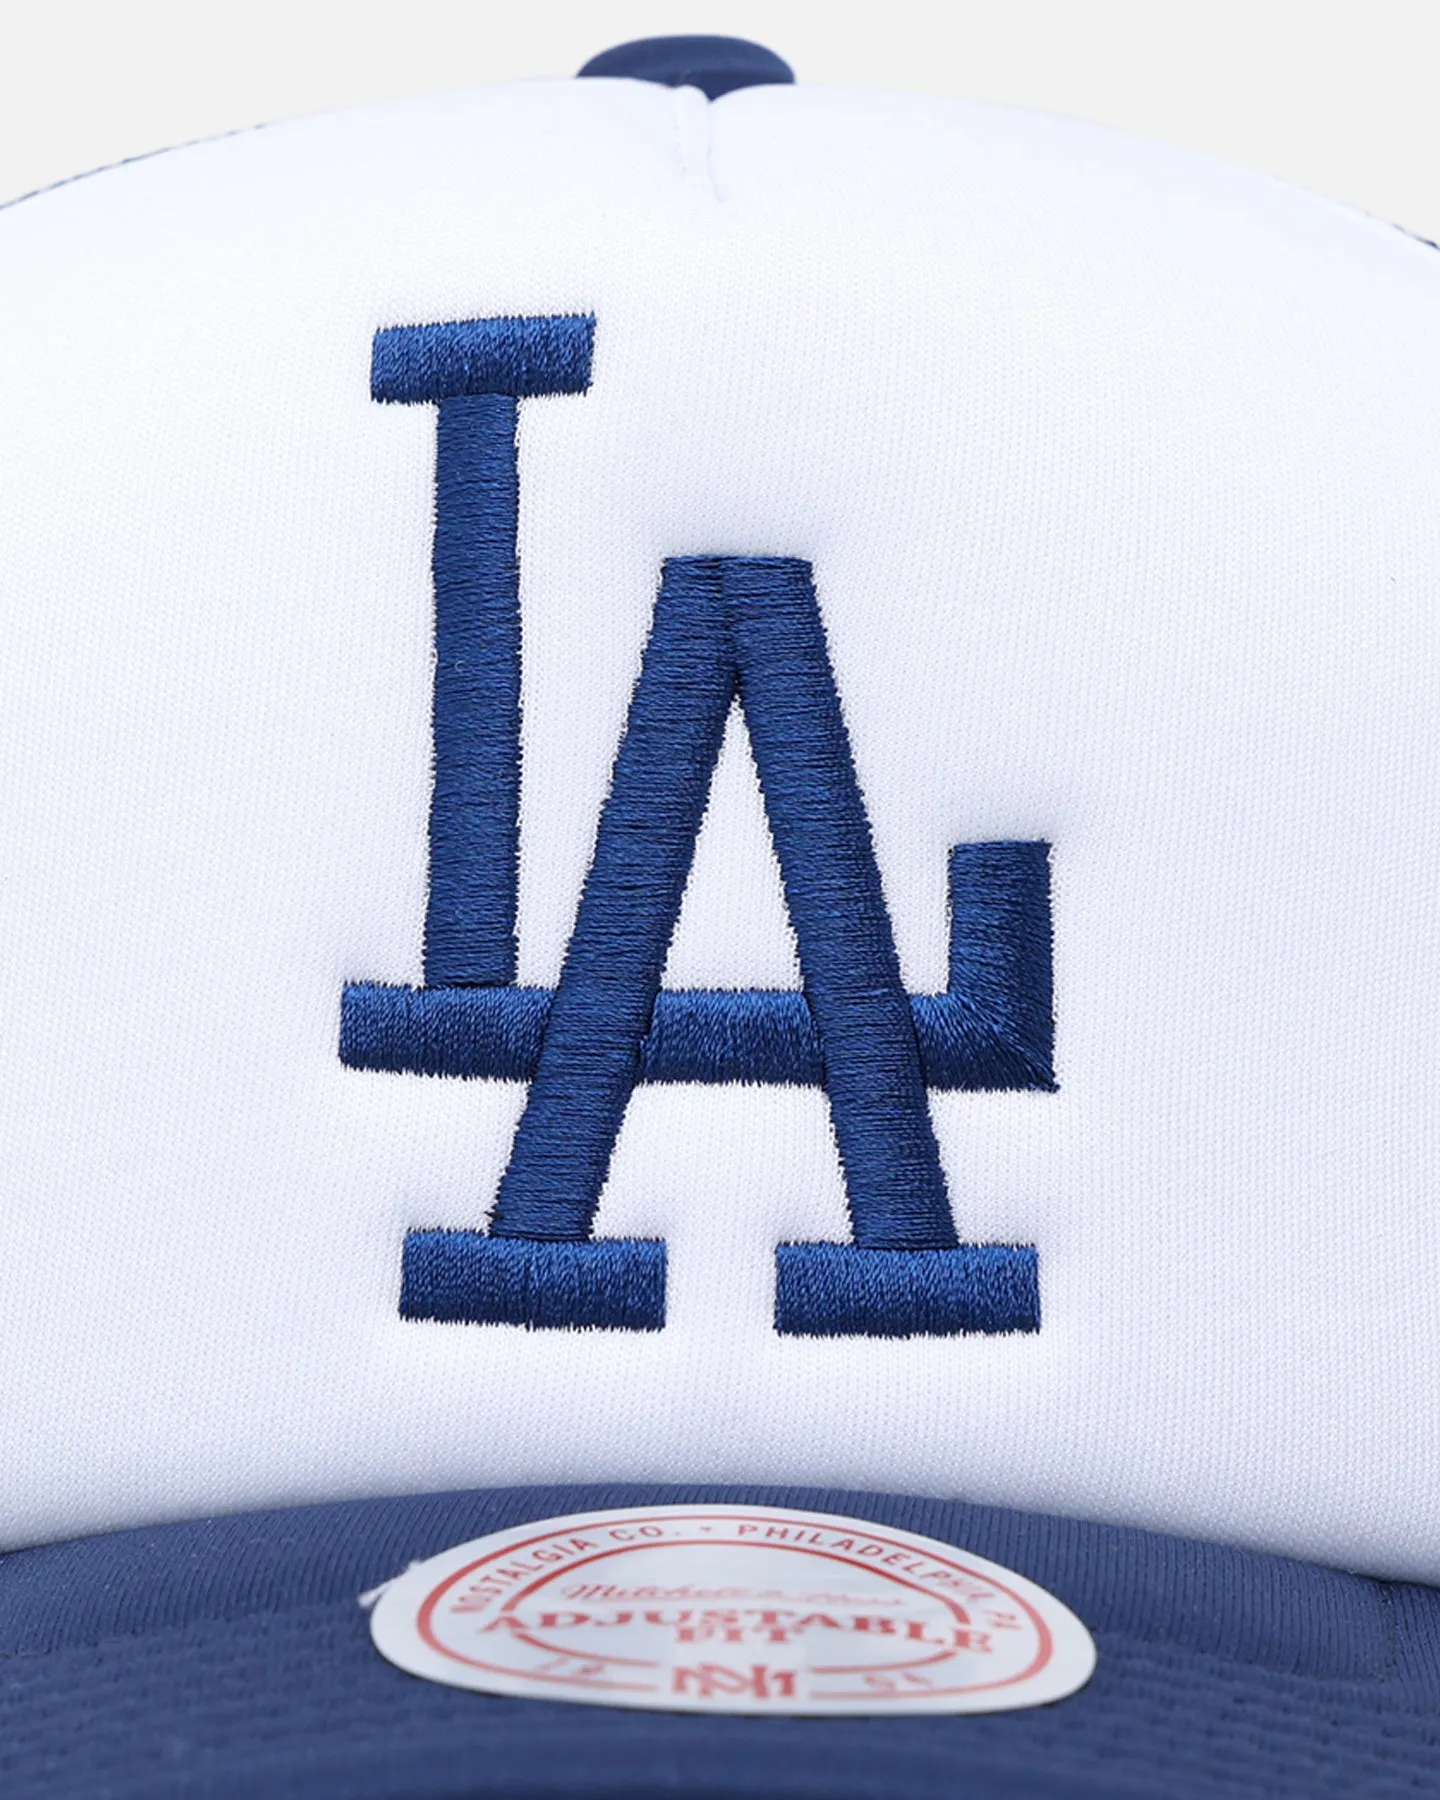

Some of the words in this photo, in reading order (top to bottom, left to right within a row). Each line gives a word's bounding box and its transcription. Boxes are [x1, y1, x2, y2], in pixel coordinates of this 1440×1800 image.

[339, 311, 1060, 1337] LA
[449, 1536, 599, 1614] NOSTALGIA
[475, 1608, 994, 1654] ADJUSTABLE
[675, 1624, 806, 1646] FIT
